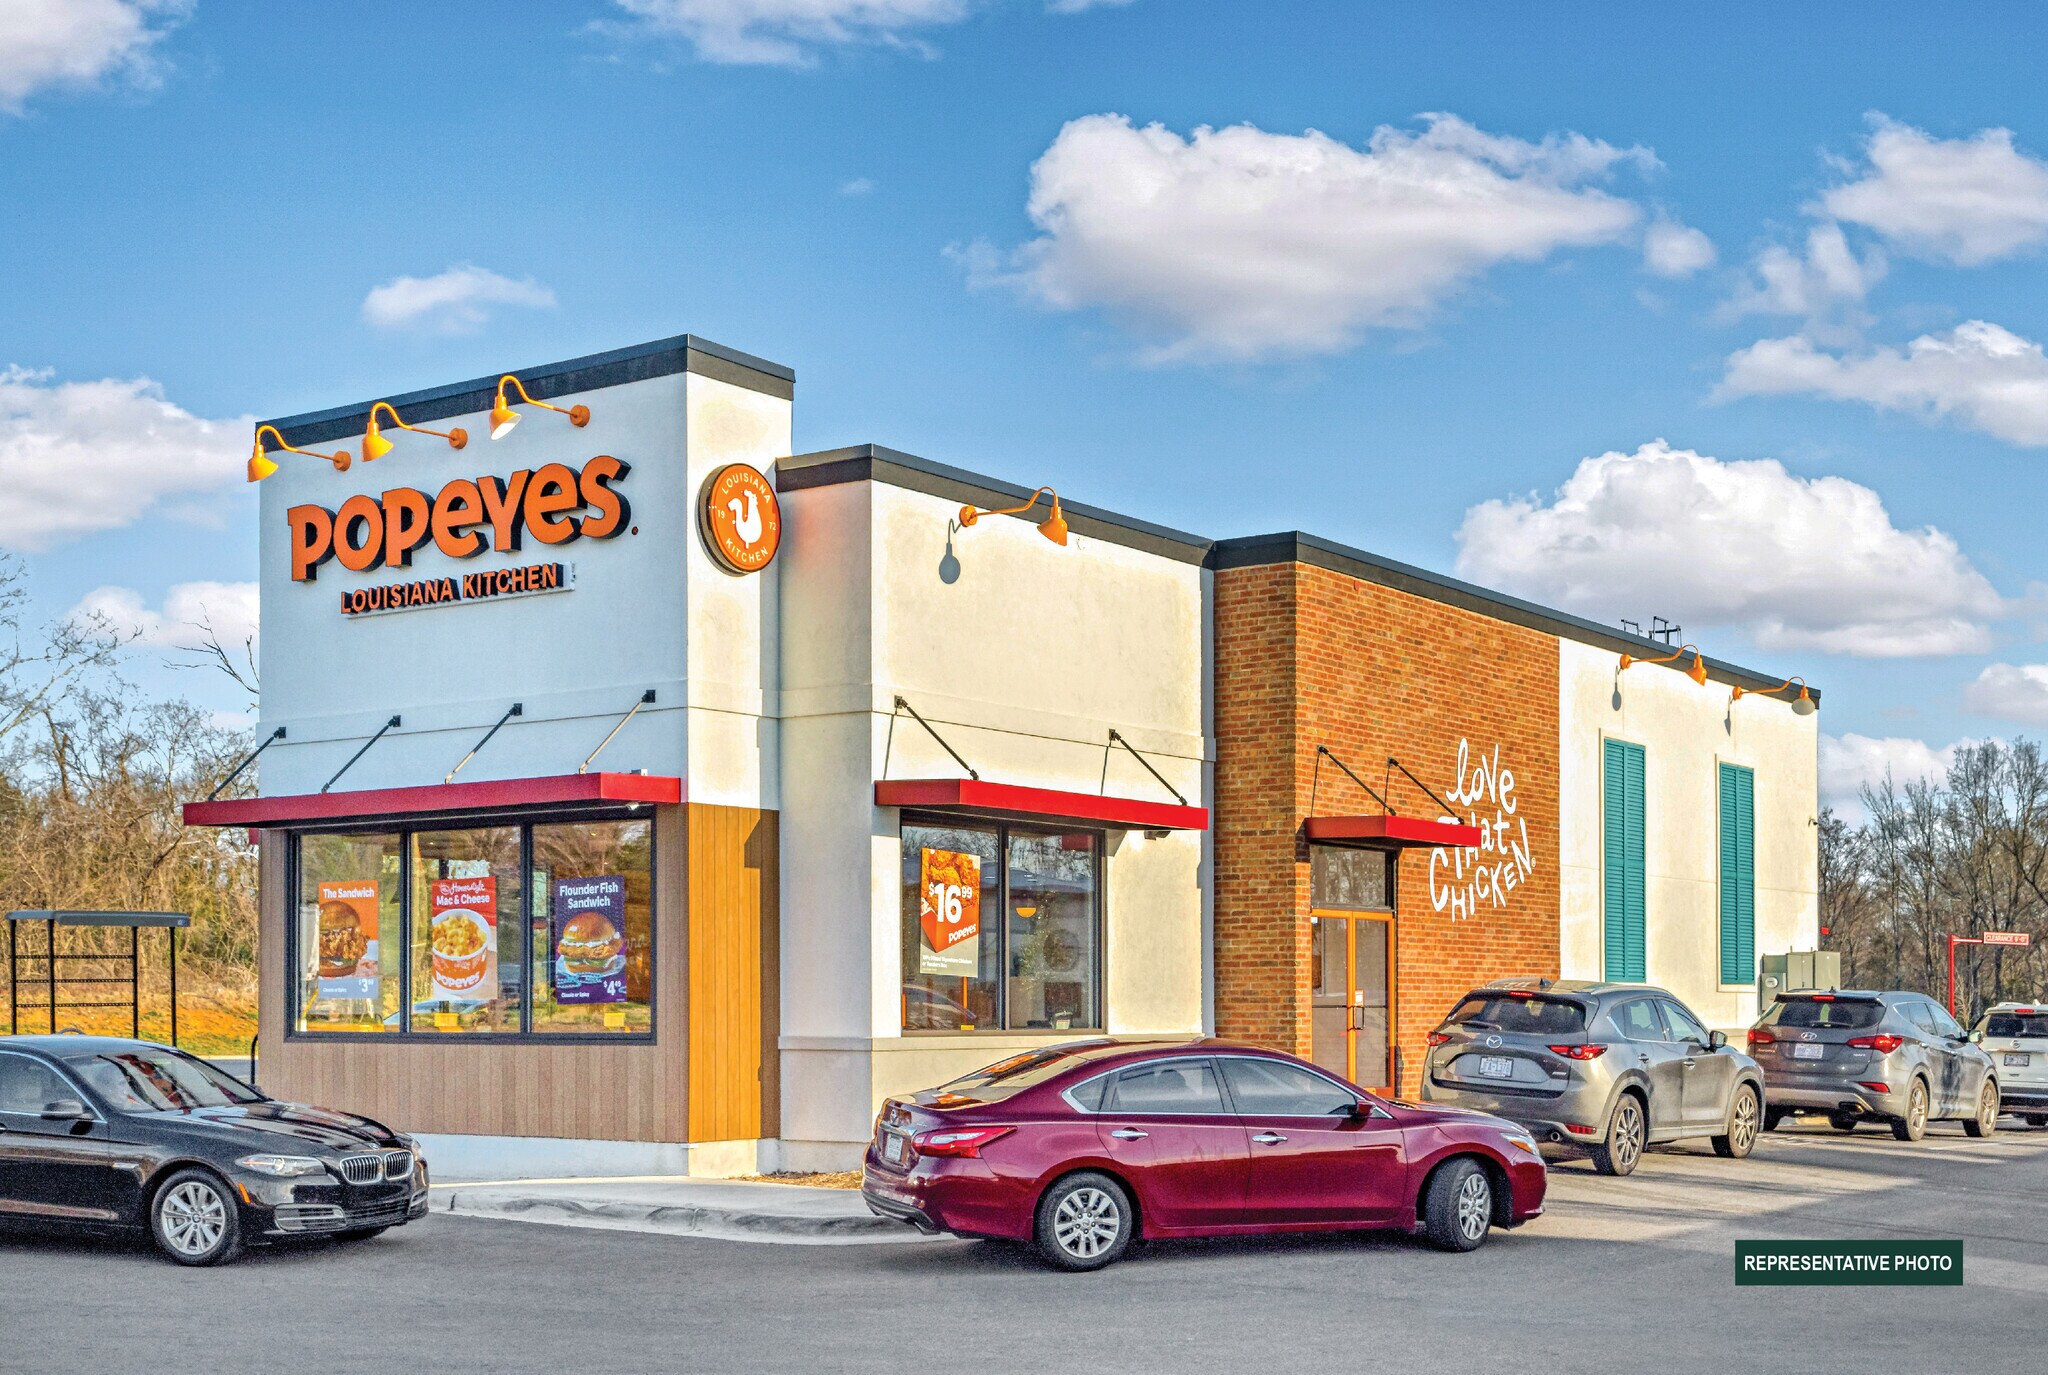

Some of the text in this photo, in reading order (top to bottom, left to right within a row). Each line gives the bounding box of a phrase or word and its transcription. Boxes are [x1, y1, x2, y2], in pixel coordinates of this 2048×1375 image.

[722, 472, 771, 504] LOUISIANA
[725, 537, 769, 564] KITCHEN
[341, 563, 561, 615] LOUISIANA KITCHEN
[1429, 816, 1533, 923] CHICKEN
[323, 887, 375, 899] The Sandwich
[560, 881, 619, 897] Flounder Fish
[436, 894, 490, 907] Mac & Cheese
[567, 895, 611, 909] Sandwich
